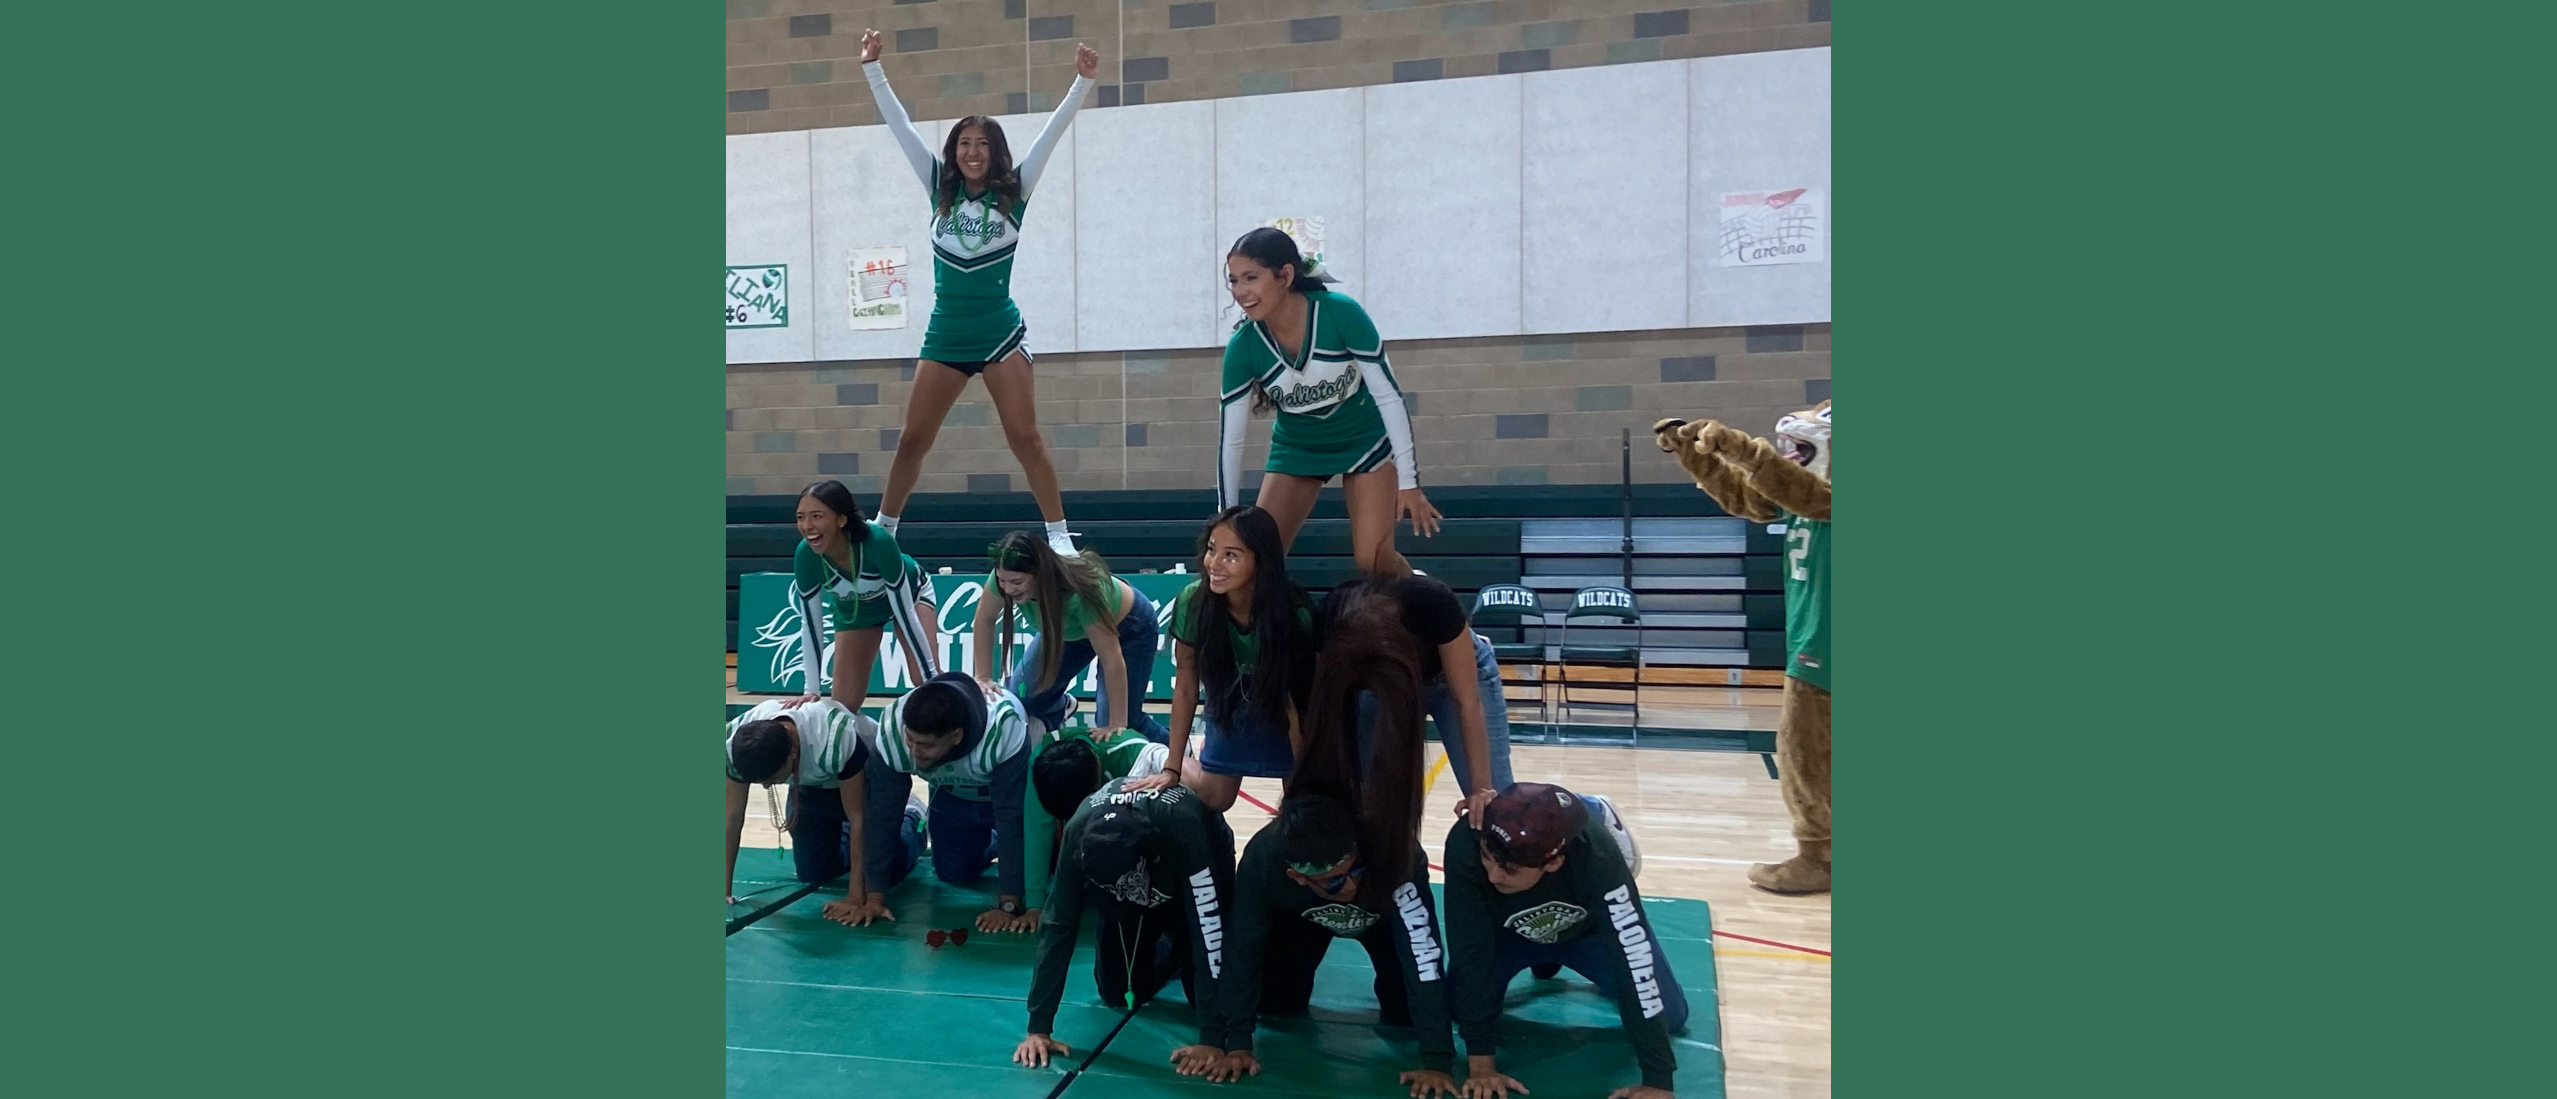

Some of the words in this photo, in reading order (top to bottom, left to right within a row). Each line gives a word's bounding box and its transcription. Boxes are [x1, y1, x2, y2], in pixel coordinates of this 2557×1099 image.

[1268, 365, 1356, 408] Calistoga
[1482, 590, 1533, 607] WILDCATS
[1577, 591, 1631, 608] WILDCATS
[1604, 884, 1664, 1019] PALOMERA
